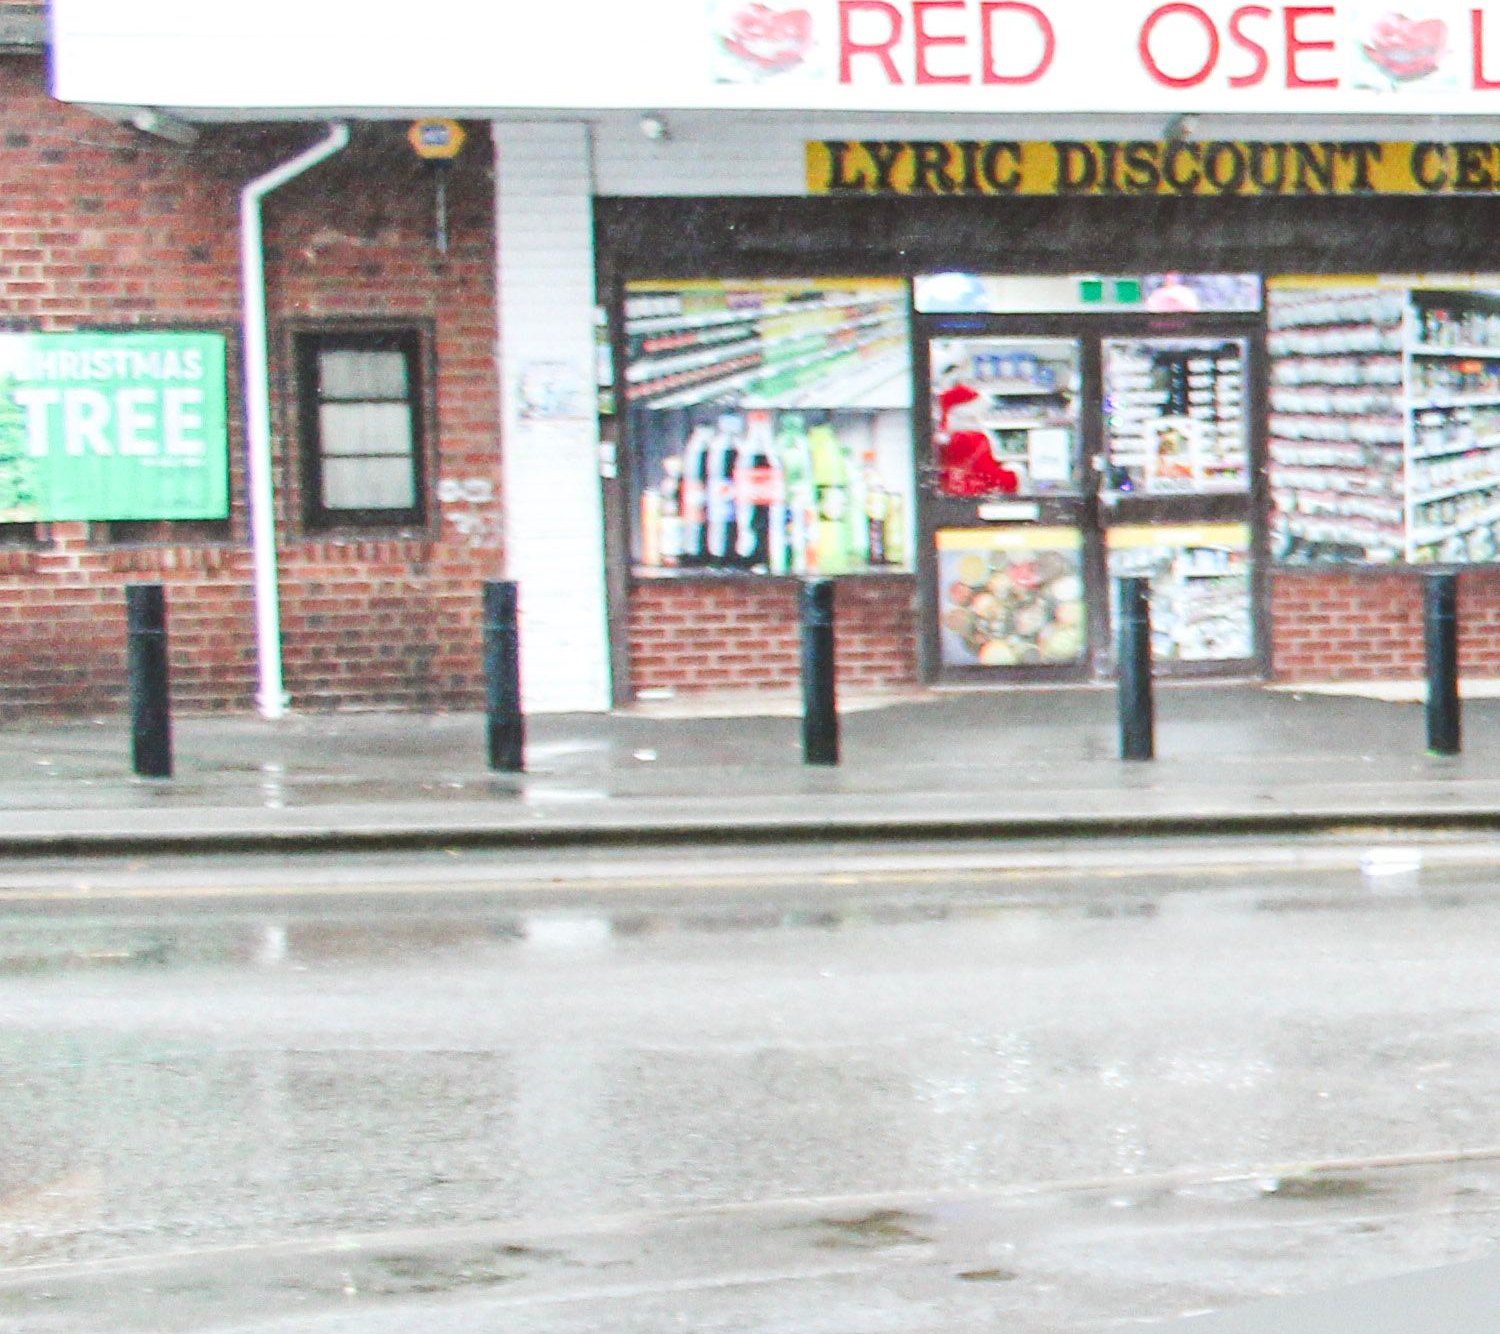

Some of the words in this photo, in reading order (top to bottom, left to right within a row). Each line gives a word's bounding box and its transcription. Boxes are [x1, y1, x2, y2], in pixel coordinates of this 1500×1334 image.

[837, 0, 1056, 86] RED
[1138, 1, 1340, 90] OSE
[824, 140, 1023, 190] LYRIC
[1053, 140, 1382, 191] DISCOUNT
[13, 386, 207, 458] TREE
